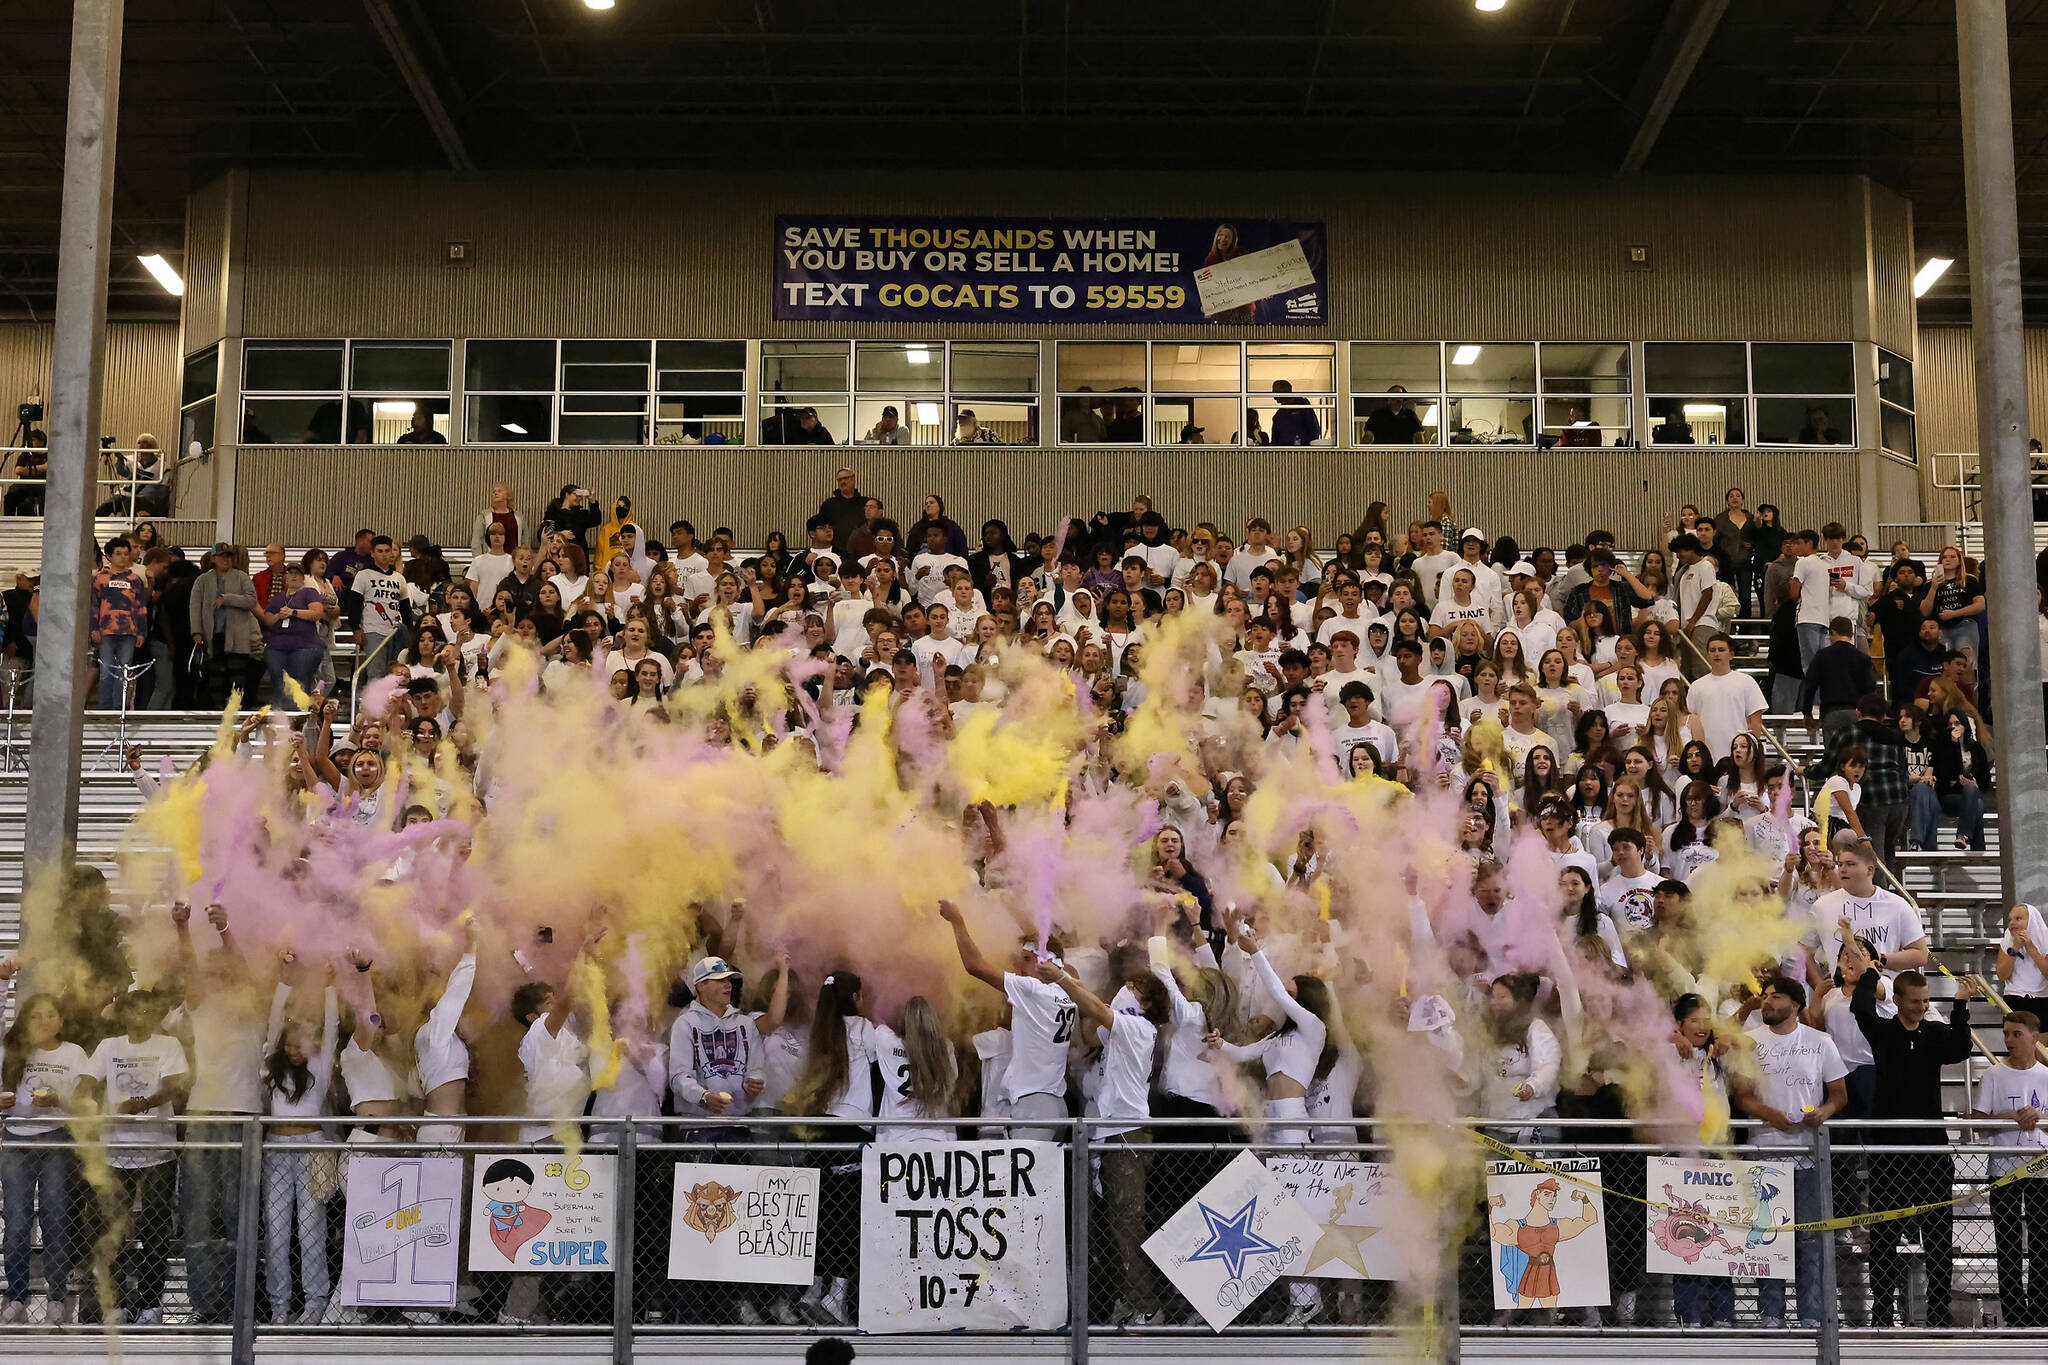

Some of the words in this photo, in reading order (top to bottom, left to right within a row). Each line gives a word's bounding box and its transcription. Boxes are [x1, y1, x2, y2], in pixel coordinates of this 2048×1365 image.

[784, 227, 861, 249] SAVE
[869, 228, 1054, 250] THOUSANDS
[1063, 229, 1156, 250] WHEN
[783, 250, 851, 272] YOU
[856, 250, 917, 272] BUY
[923, 251, 967, 273] OR
[974, 251, 1045, 273] SELL
[1052, 252, 1075, 273] A
[1084, 252, 1180, 273] HOME!
[783, 282, 868, 307] TEXT
[878, 284, 1019, 309] GOCATS
[1028, 284, 1076, 309] TO
[1086, 285, 1185, 310] 59559
[1448, 611, 1456, 619] I
[1459, 608, 1485, 618] HAVE
[1843, 900, 1873, 921] I'M
[544, 1155, 591, 1191] #6
[879, 1147, 1037, 1204] POWDER
[1292, 1160, 1324, 1177] Will
[1334, 1162, 1360, 1181] Not
[1683, 1170, 1734, 1187] PANIC
[768, 1178, 790, 1190] MY
[565, 1191, 583, 1199] NOT
[747, 1191, 810, 1218] BESTIE
[1705, 1192, 1741, 1201] BECAUSE
[553, 1202, 595, 1211] SUPERMAN
[555, 1226, 577, 1234] SURE
[584, 1226, 593, 1234] IS
[566, 1216, 583, 1224] BUT
[762, 1218, 773, 1231] IS
[781, 1218, 791, 1232] A
[738, 1230, 815, 1258] BEASTIE
[895, 1207, 1008, 1262] TOSS
[529, 1240, 610, 1266] SUPER
[1744, 1252, 1770, 1262] BRING
[1216, 1235, 1303, 1312] Parker
[1727, 1261, 1771, 1276] PAIN
[919, 1273, 980, 1309] 10-7
